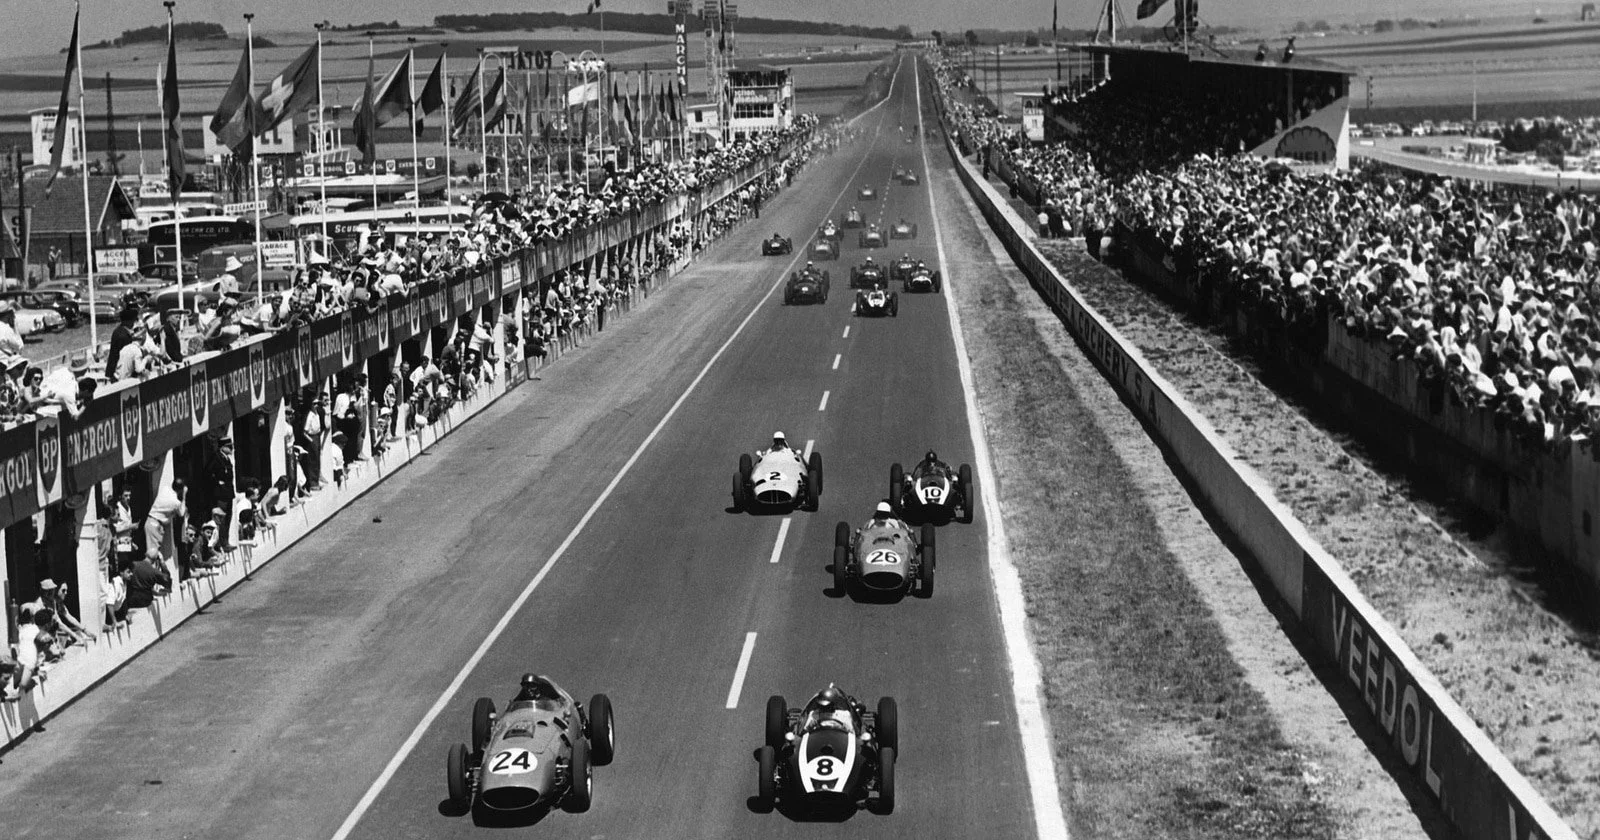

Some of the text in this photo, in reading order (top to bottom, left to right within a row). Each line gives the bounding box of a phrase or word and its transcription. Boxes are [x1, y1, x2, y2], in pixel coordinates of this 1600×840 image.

[41, 440, 57, 474] BP
[67, 418, 118, 468] ENERGOL
[125, 407, 139, 440] BP
[145, 390, 190, 433] ENERGOL
[192, 384, 206, 411] BP
[252, 358, 263, 386] BP
[770, 471, 781, 481] 2
[924, 488, 942, 498] 10
[870, 551, 898, 564] 26
[1331, 591, 1441, 799] VEEDOL
[491, 750, 531, 771] 24
[816, 758, 833, 776] 8
